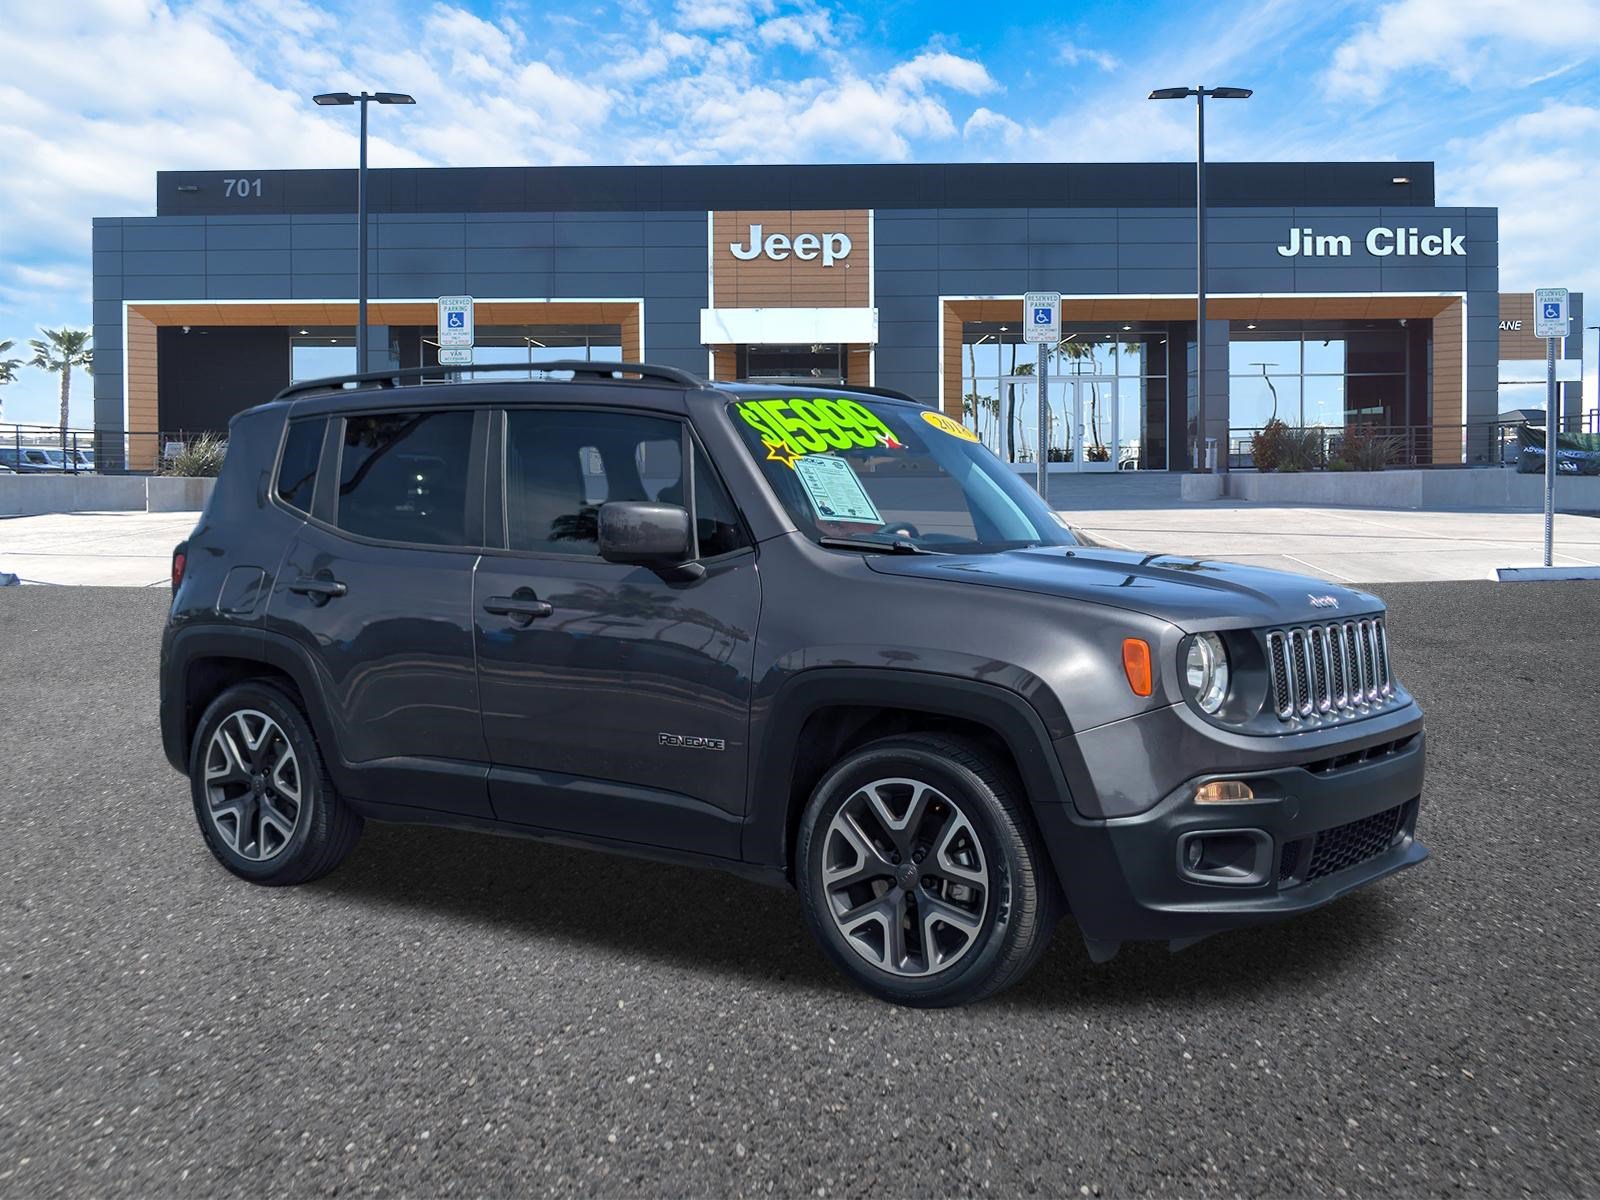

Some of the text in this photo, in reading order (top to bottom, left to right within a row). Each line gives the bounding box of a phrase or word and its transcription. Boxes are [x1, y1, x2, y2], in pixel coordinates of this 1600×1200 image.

[223, 179, 262, 197] 701
[729, 223, 852, 268] Jeep
[1277, 227, 1467, 257] Jim Click
[1498, 320, 1521, 330] ANE
[735, 398, 899, 455] $15999
[658, 732, 725, 751] RENEGADE
